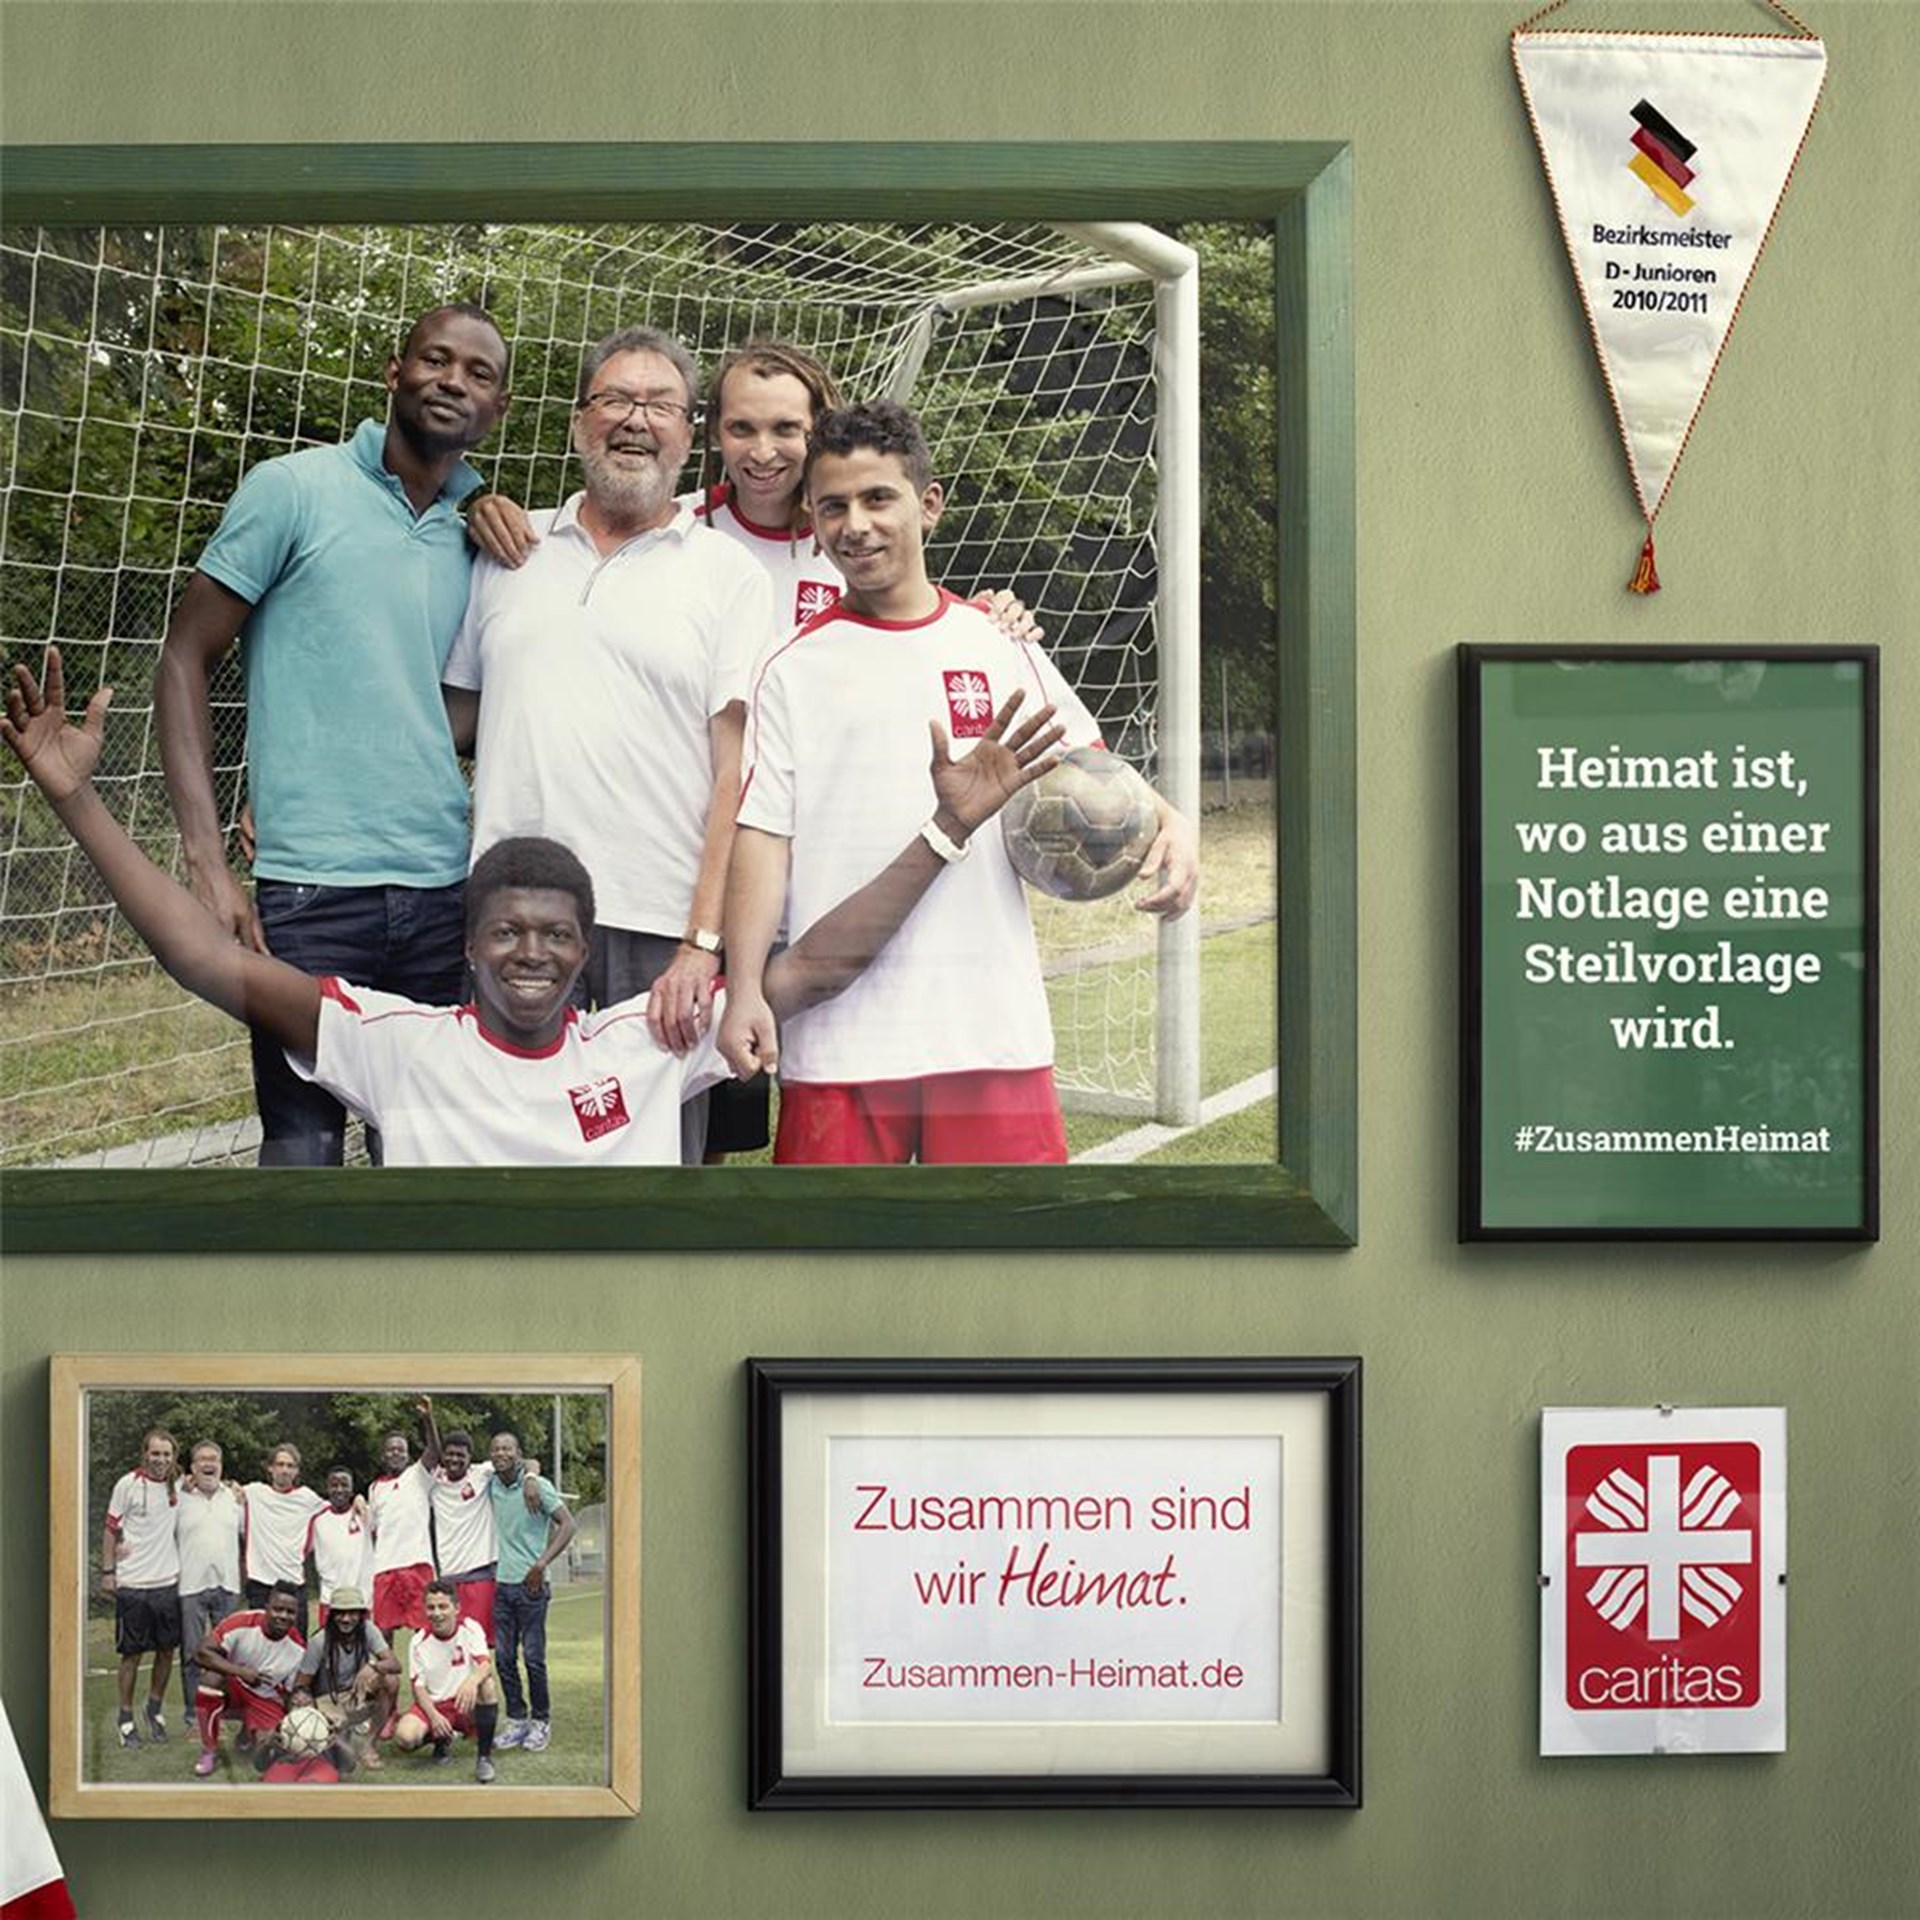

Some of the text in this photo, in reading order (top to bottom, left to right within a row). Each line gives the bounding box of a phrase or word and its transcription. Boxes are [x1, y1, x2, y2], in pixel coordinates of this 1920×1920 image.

[1593, 224, 1732, 249] Bezirksmeister
[1612, 289, 1707, 314] 2010/2011
[1537, 745, 1807, 797] Heimat ist,
[1516, 810, 1831, 853] wo aus einer
[1516, 875, 1829, 930] Notlage eine
[1525, 941, 1821, 993] Steilvorlage
[1610, 1005, 1734, 1049] wird.
[1514, 1124, 1830, 1152] #ZusammenHeimat
[853, 1486, 1251, 1531] Zusammen sind
[914, 1541, 1188, 1608] wir Heimat.
[862, 1657, 1244, 1689] Zusammen-Heimat.de
[1579, 1653, 1743, 1704] caritas
